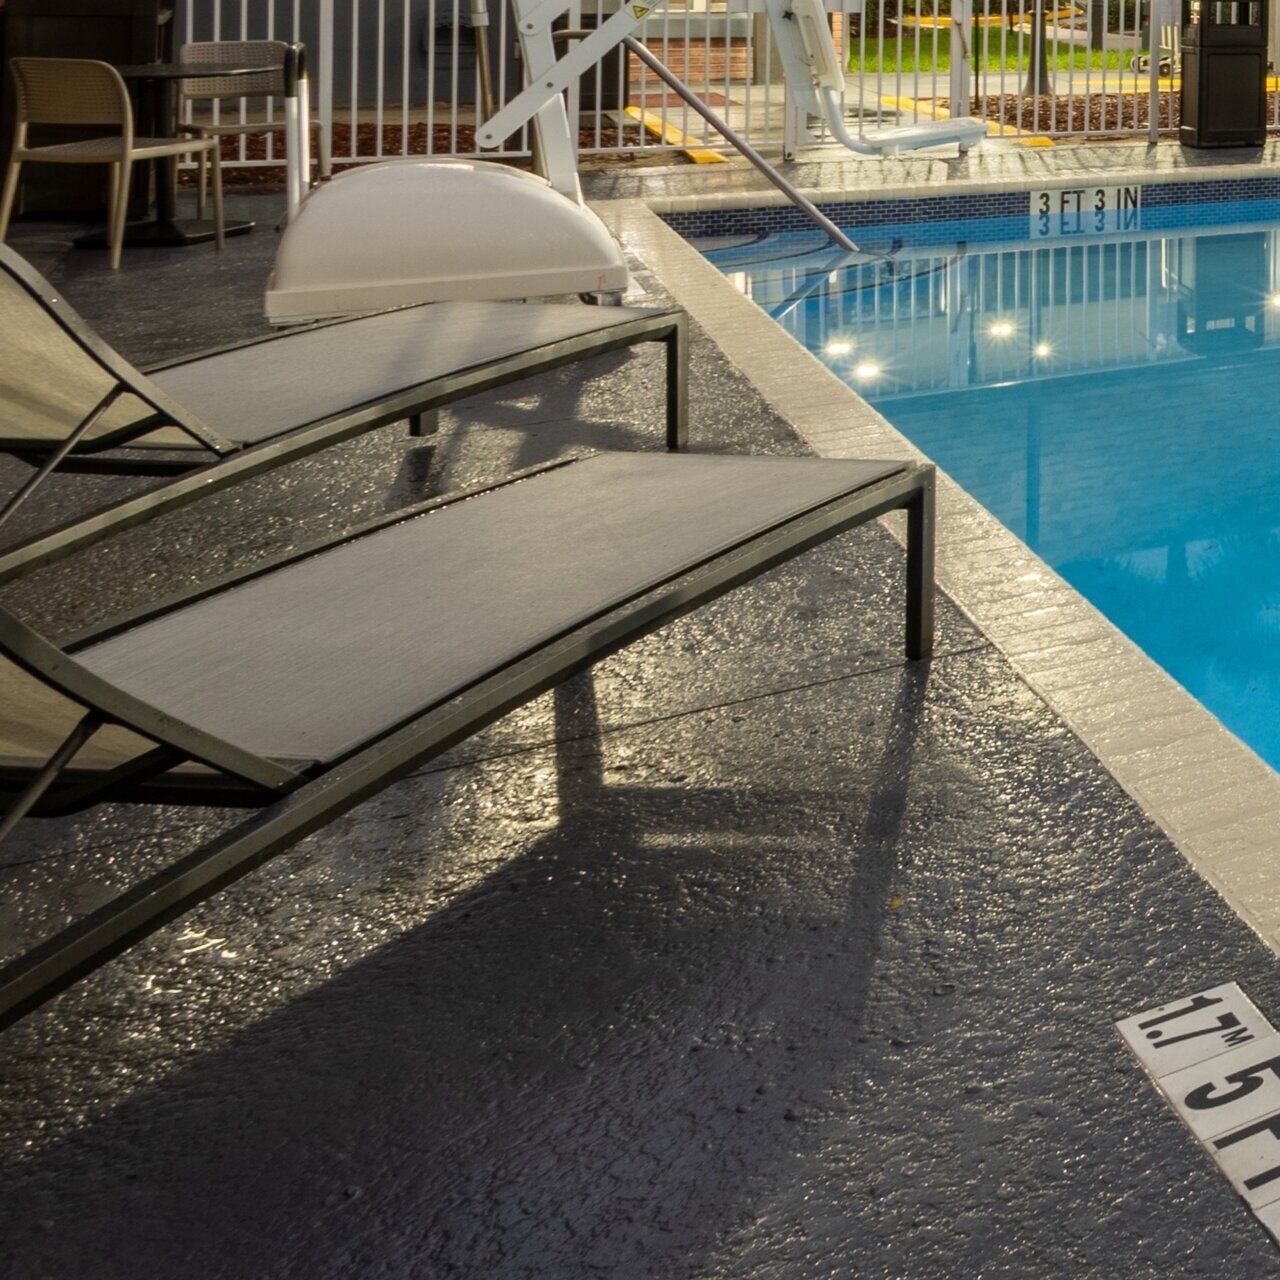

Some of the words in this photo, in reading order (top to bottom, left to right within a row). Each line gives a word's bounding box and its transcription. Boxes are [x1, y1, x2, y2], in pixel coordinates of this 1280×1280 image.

[1039, 193, 1050, 214] 3
[1060, 190, 1085, 213] FT
[1095, 189, 1105, 211] 3
[1117, 187, 1138, 211] IN
